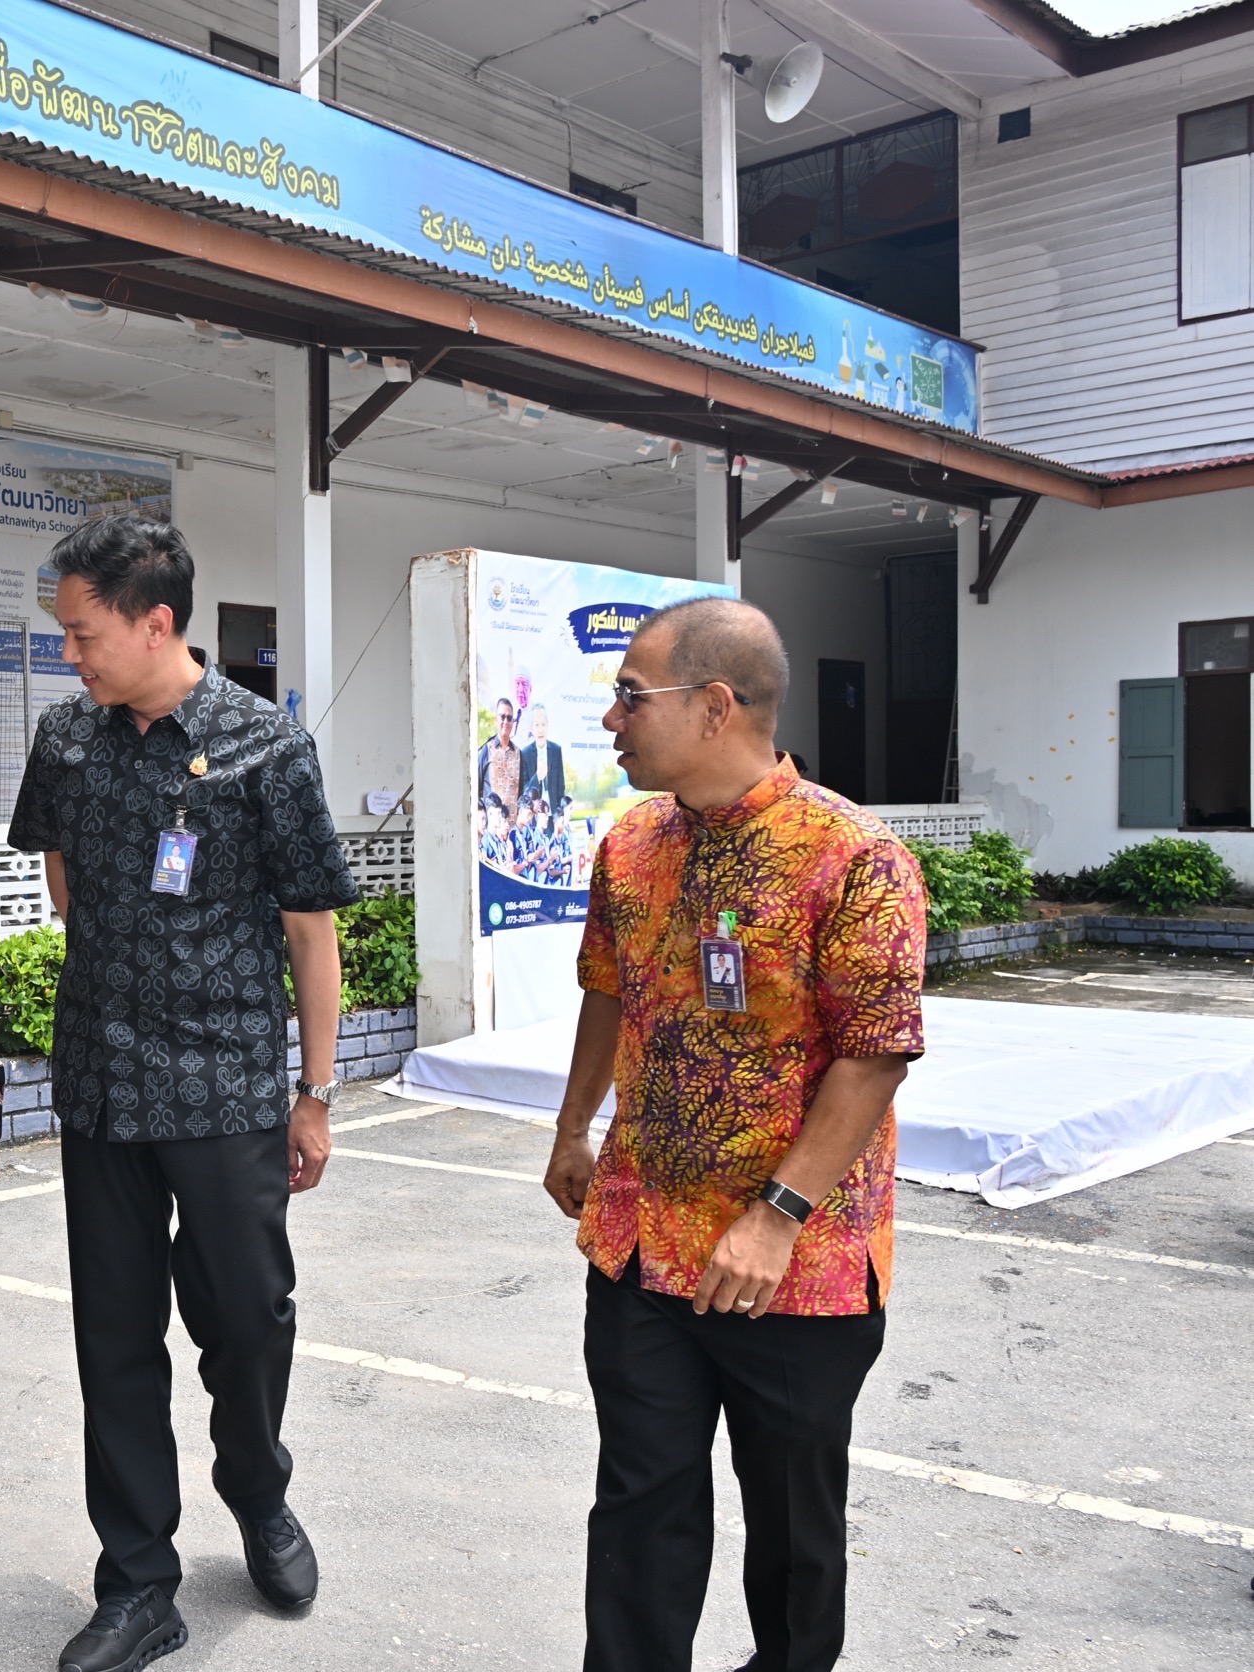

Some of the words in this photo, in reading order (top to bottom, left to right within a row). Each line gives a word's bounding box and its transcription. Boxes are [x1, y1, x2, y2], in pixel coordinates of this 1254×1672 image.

[421, 208, 487, 257] مشاركة
[492, 238, 521, 271] دان
[525, 244, 589, 283] شخصية
[648, 292, 690, 320] أساس
[263, 653, 276, 663] 116
